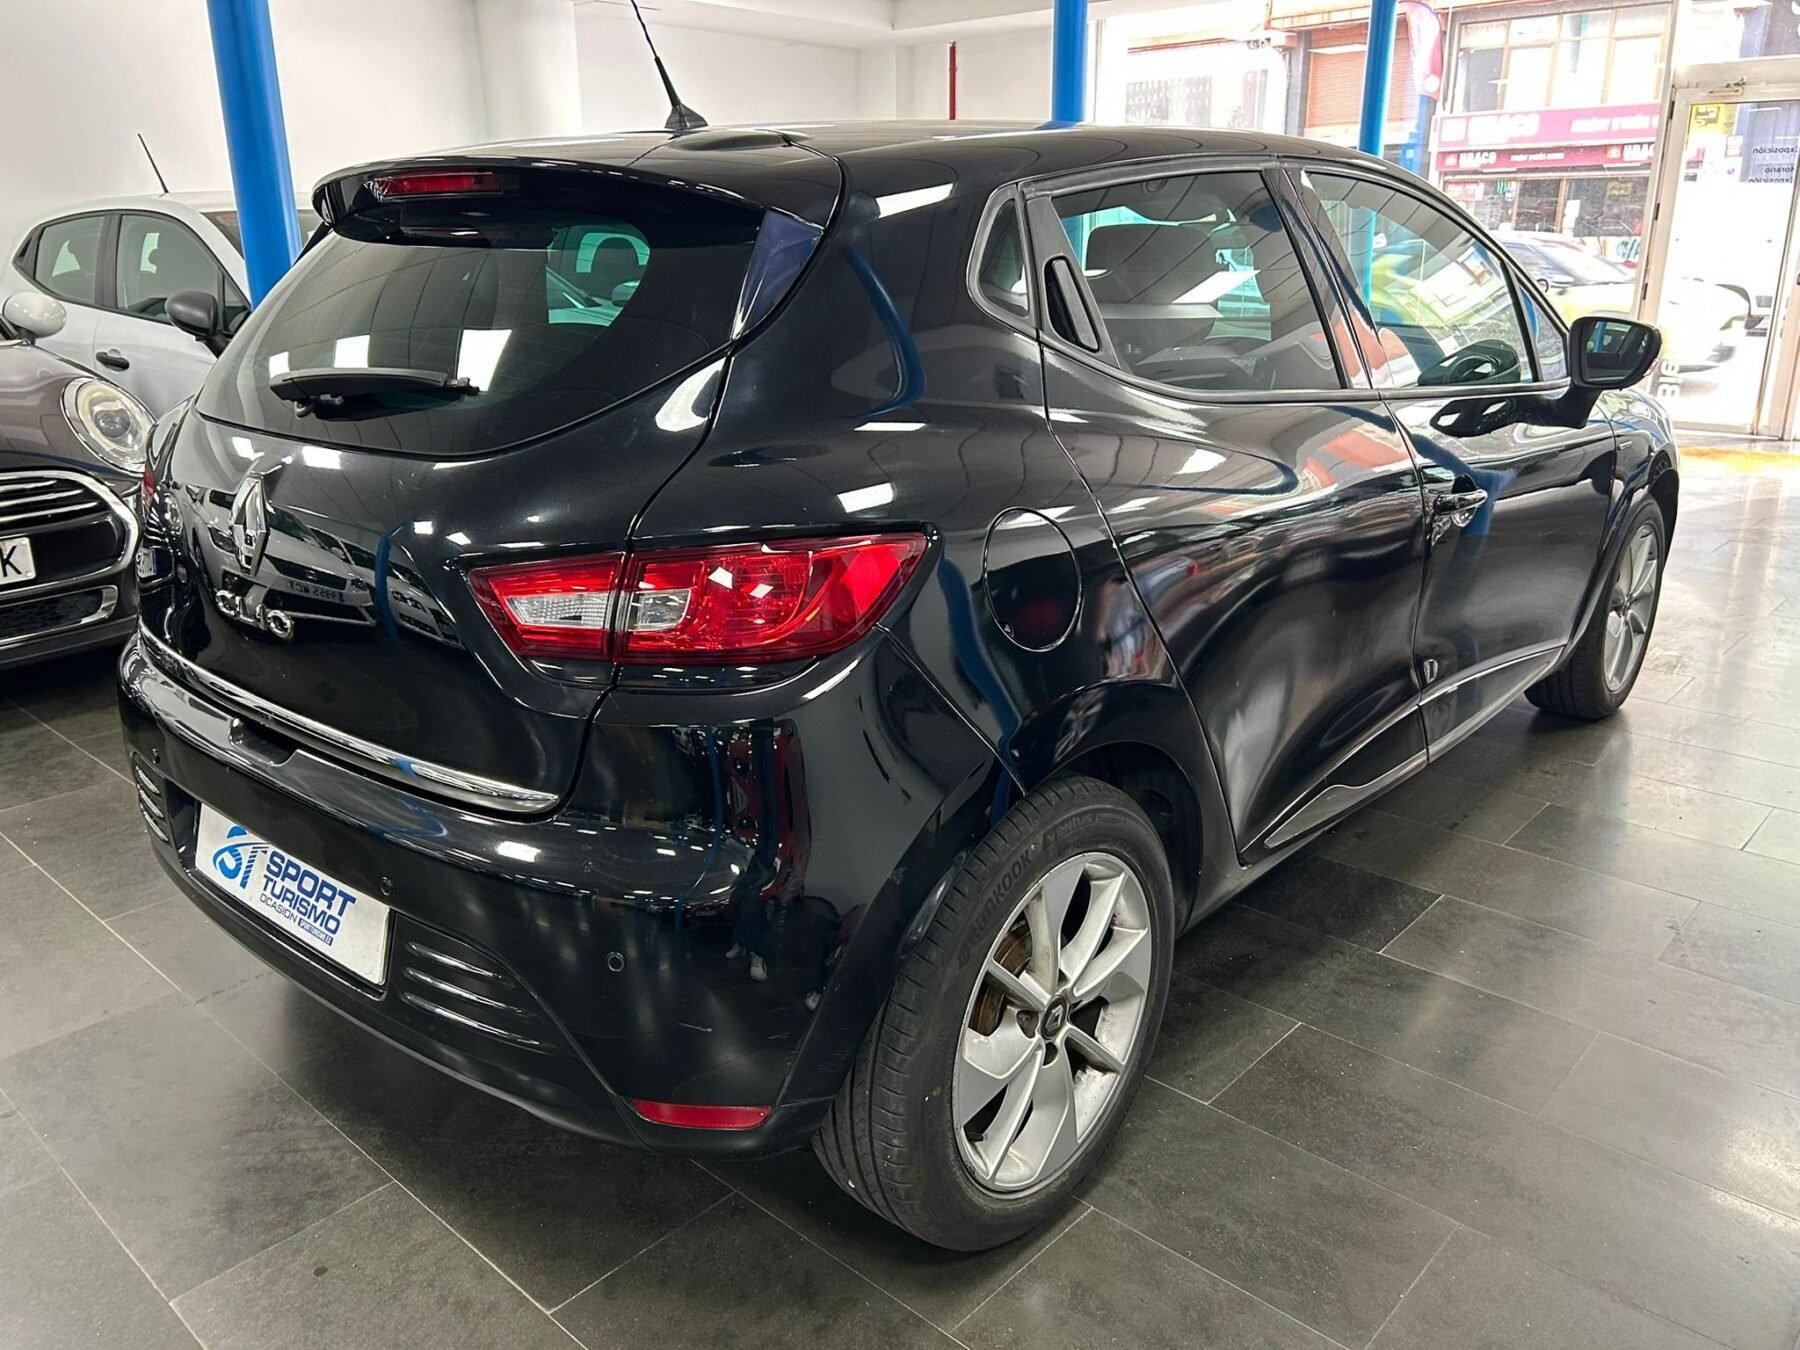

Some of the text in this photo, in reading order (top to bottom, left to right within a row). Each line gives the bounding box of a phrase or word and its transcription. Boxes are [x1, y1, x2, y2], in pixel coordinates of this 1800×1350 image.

[260, 893, 298, 923] OCASION
[263, 874, 341, 935] TURISMO
[266, 850, 357, 917] SPORT
